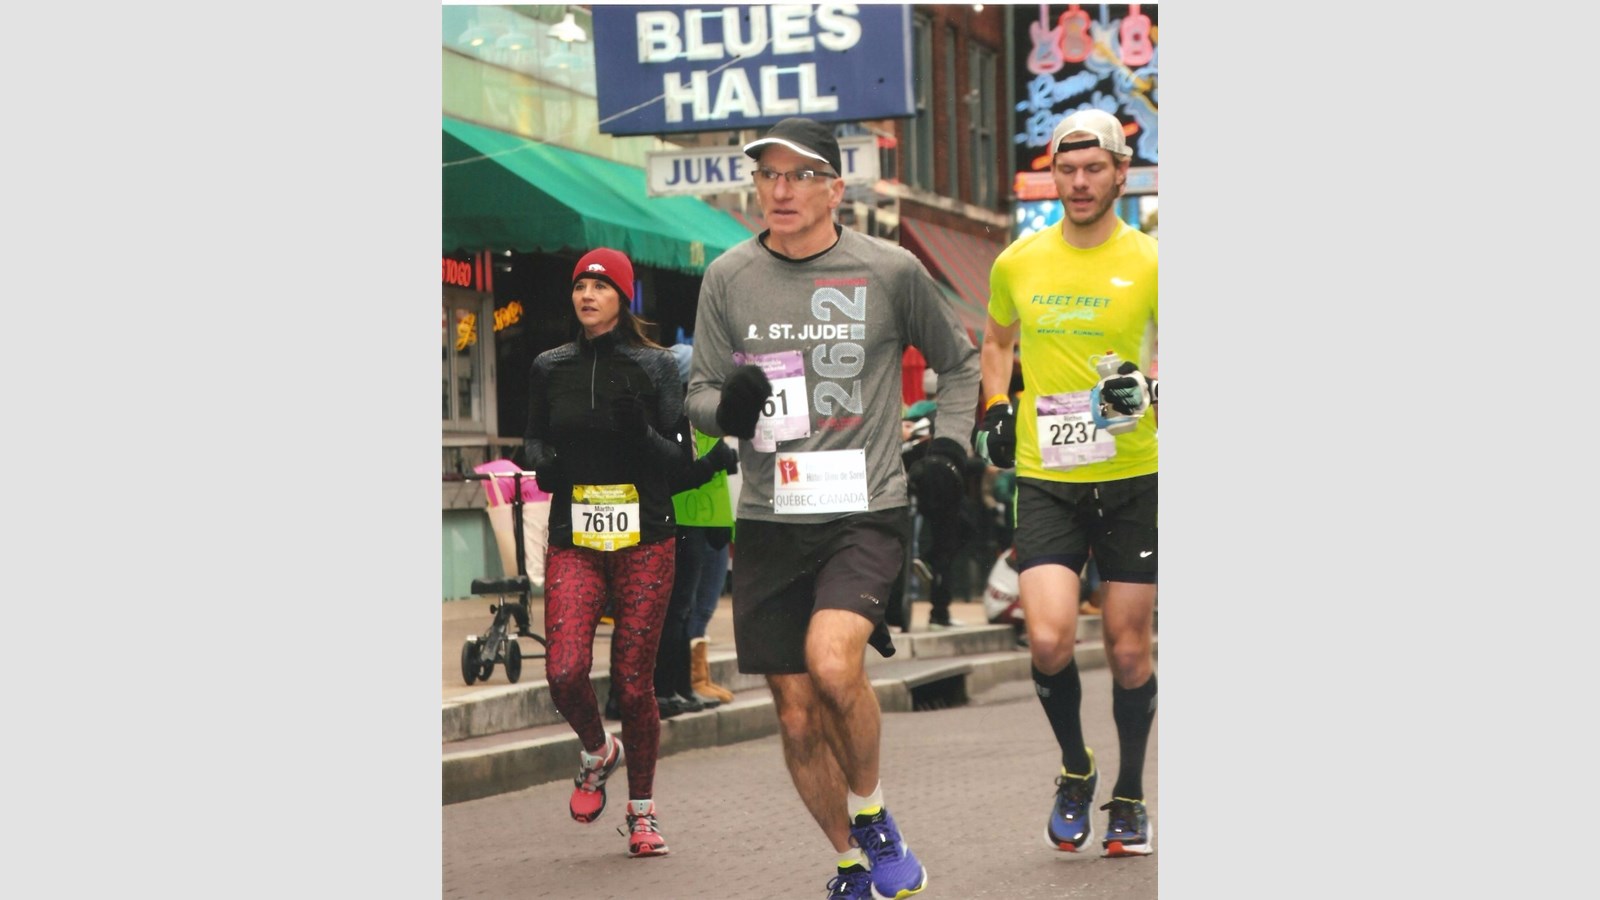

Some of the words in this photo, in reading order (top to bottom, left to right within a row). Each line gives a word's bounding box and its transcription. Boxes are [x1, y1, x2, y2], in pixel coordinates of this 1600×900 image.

[636, 4, 862, 63] BLUES
[664, 62, 839, 123] HALL
[666, 156, 744, 185] JUKE
[1031, 295, 1073, 305] FLEET
[1075, 296, 1112, 308] FEET
[768, 323, 795, 340] ST.
[798, 324, 849, 340] JUDE
[1050, 421, 1097, 446] 2237
[776, 493, 817, 507] QUÉBEC,
[819, 492, 866, 505] CANADA
[582, 511, 628, 532] 7610
